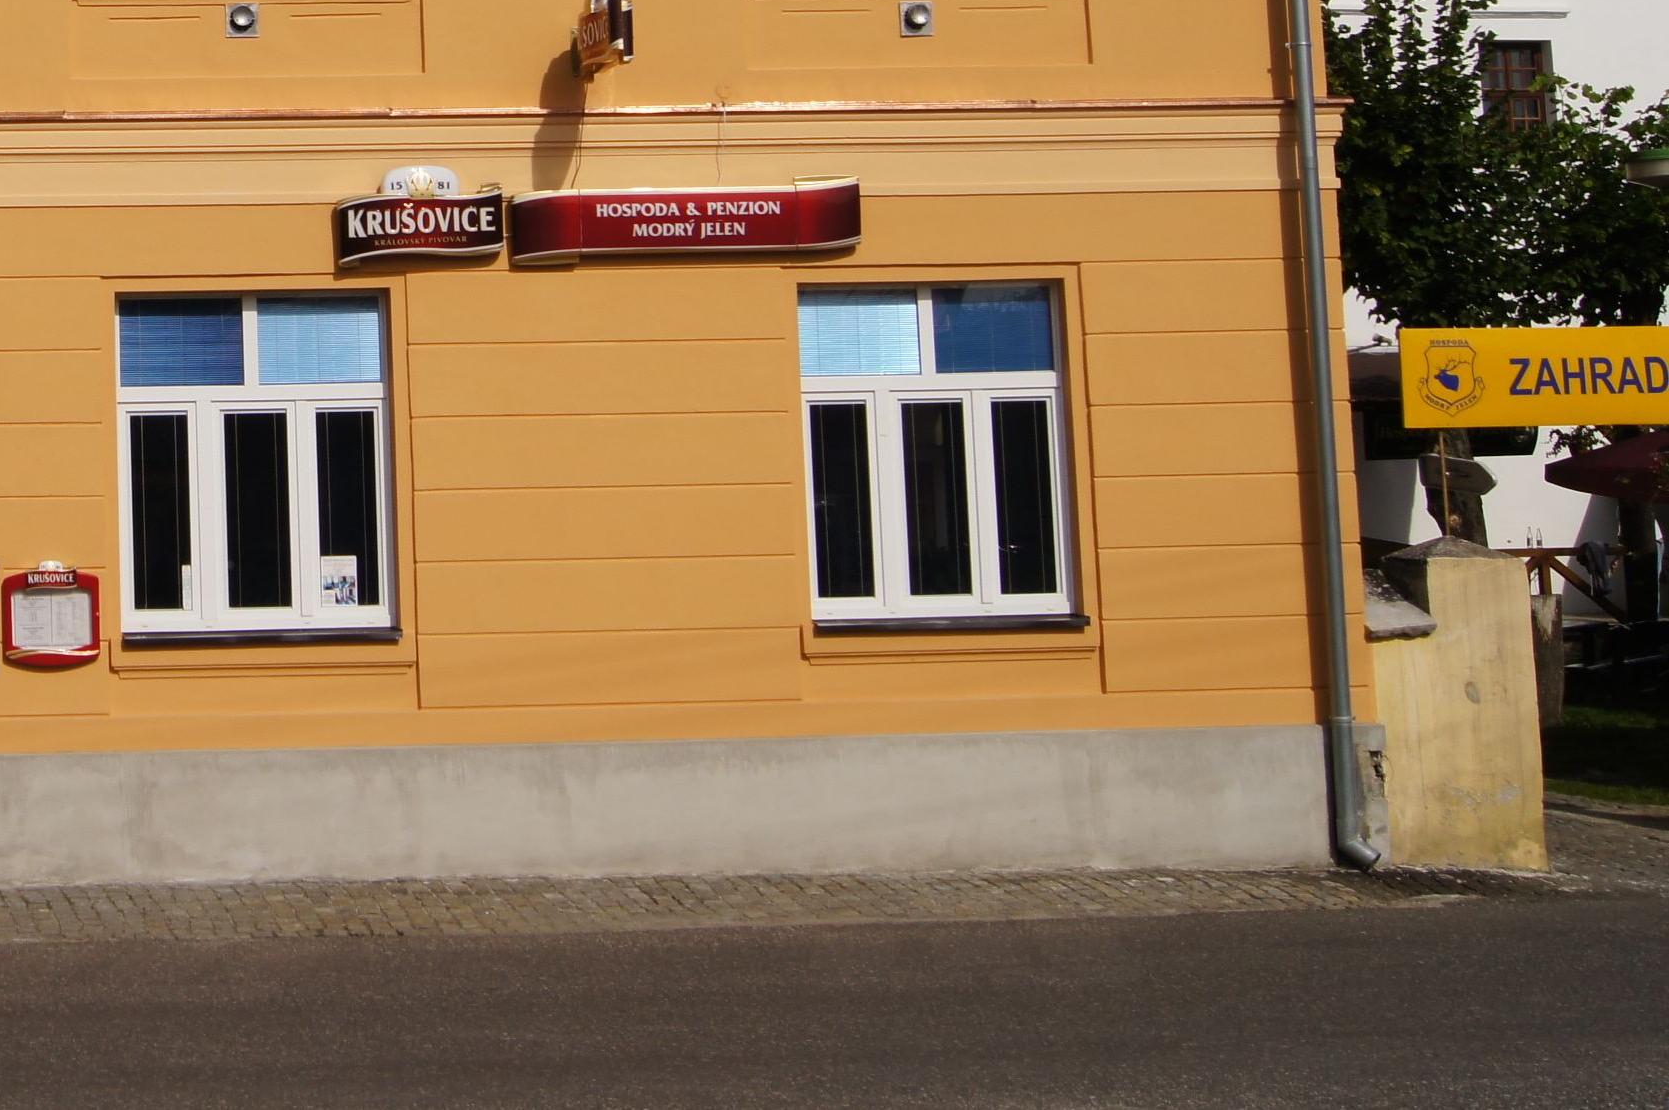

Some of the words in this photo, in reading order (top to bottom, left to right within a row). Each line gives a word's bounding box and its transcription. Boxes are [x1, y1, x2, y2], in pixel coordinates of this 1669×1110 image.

[390, 181, 403, 191] 15
[437, 181, 451, 190] 81
[595, 202, 680, 218] HOSPODA
[686, 202, 702, 217] &
[707, 200, 781, 216] PENZION
[347, 202, 497, 239] KRUŠOVICE
[632, 219, 695, 237] MODRÝ
[699, 221, 746, 239] JELEN
[428, 235, 468, 244] PIVOVAR
[1508, 356, 1669, 396] ZAHRAD
[27, 571, 75, 585] KRUŠOVICE
